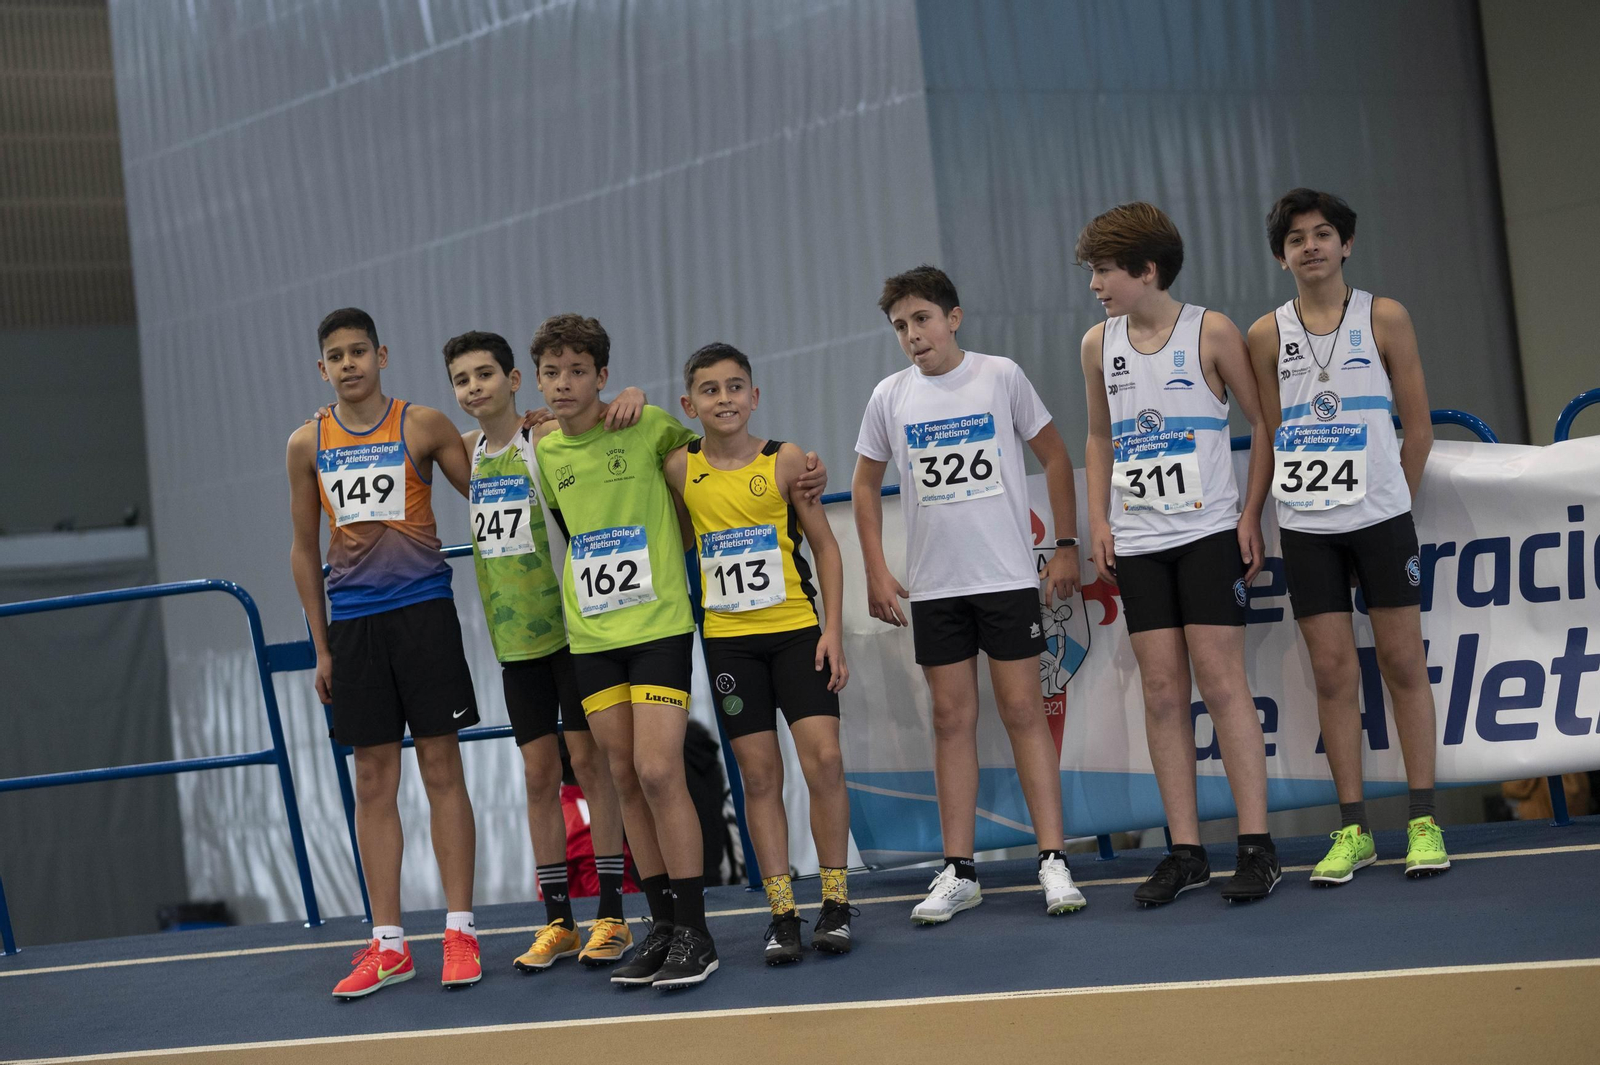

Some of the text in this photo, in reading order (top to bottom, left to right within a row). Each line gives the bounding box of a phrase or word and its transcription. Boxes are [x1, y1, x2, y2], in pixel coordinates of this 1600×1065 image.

[924, 417, 988, 433] Federación Galega
[1294, 426, 1361, 436] Federación Galega
[934, 429, 969, 440] Atletismo
[1127, 431, 1188, 446] Federación Galega
[1303, 436, 1339, 444] Atletismo
[336, 445, 398, 457] Federación Galega
[1135, 442, 1168, 452] Atletismo
[345, 455, 379, 464] Atletismo
[555, 464, 573, 481] OPTI
[920, 449, 992, 487] 326
[478, 478, 524, 488] Federación Galega
[1126, 463, 1185, 498] 311
[1280, 460, 1358, 492] 324
[558, 475, 575, 492] PRO
[331, 474, 394, 508] 149
[482, 488, 506, 496] Atletismo
[922, 492, 955, 502] atletismo.gal
[475, 509, 522, 542] 247
[583, 528, 640, 543] Federación Galega
[712, 528, 772, 542] Federación Galega
[590, 540, 620, 550] Atletismo
[719, 539, 753, 549] Atletismo
[580, 560, 640, 597] 162
[714, 559, 770, 596] 113
[645, 692, 683, 706] Lucus
